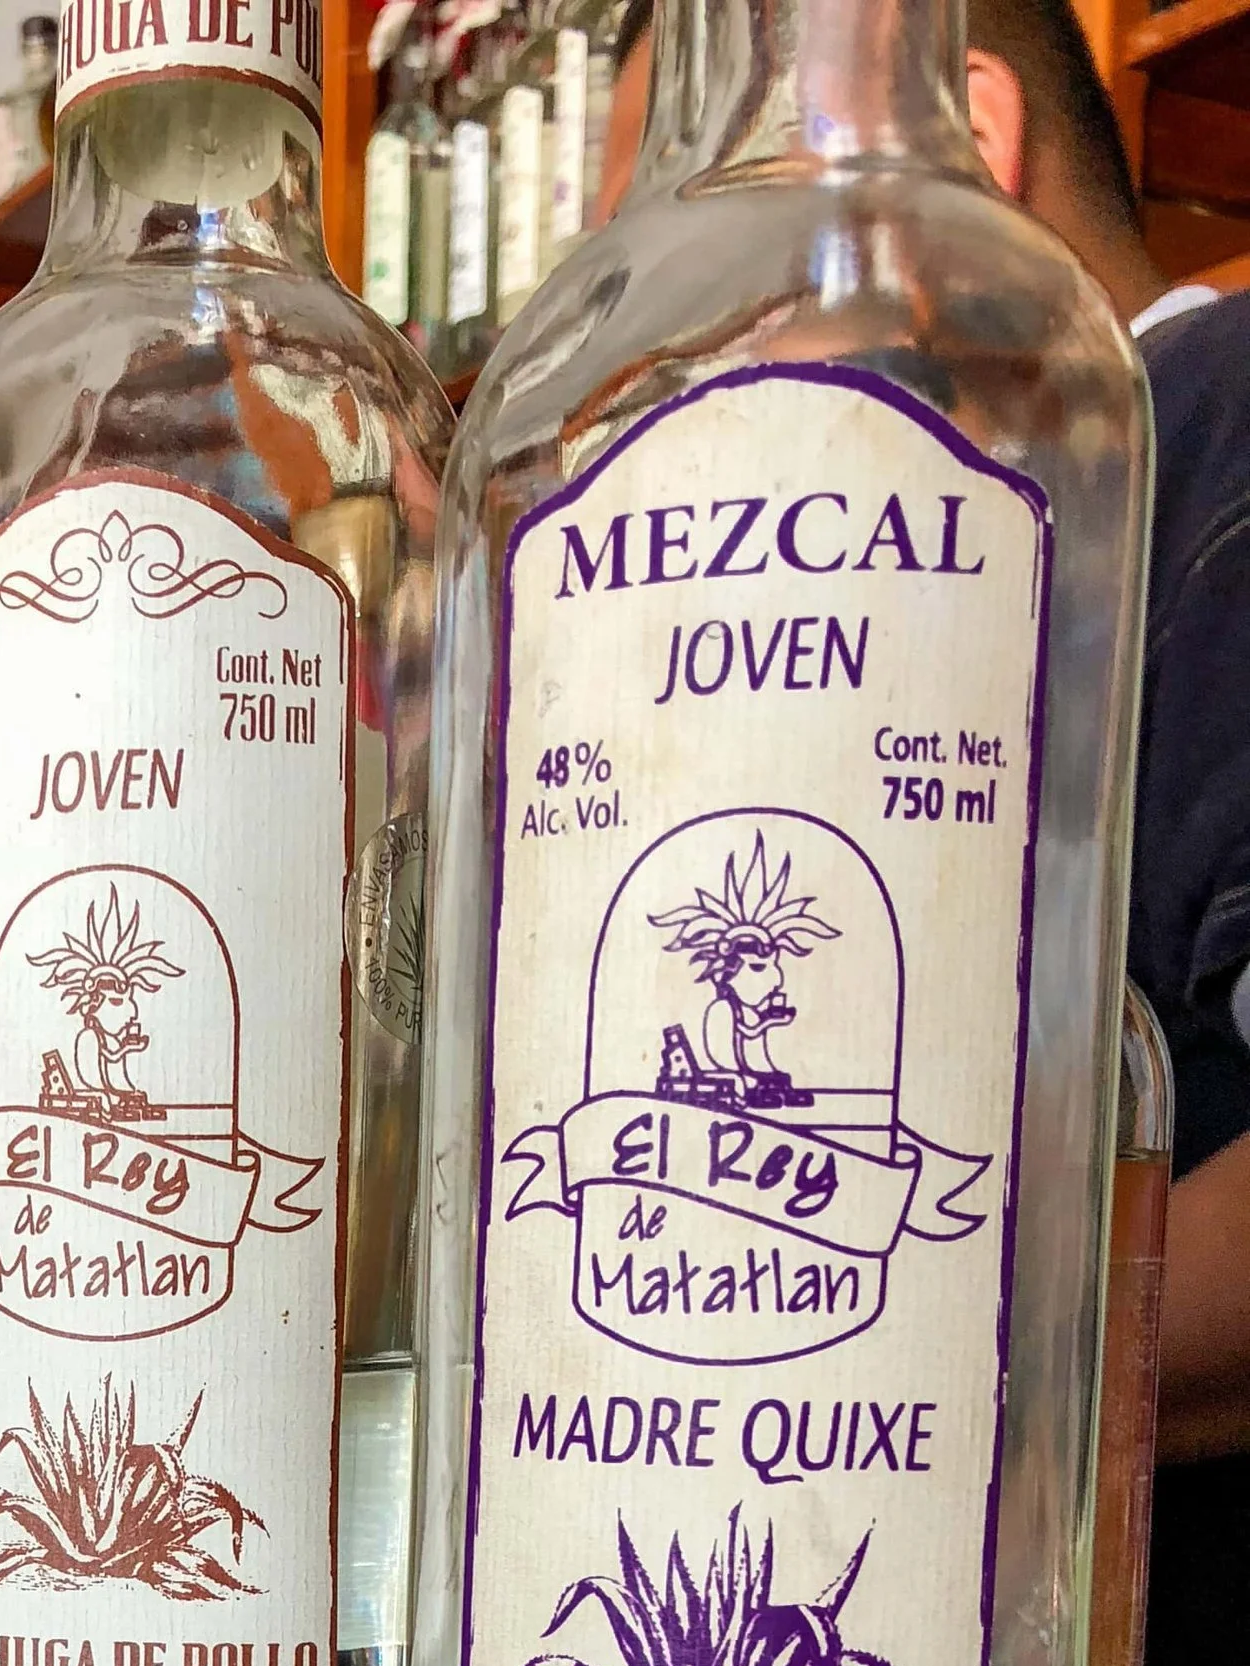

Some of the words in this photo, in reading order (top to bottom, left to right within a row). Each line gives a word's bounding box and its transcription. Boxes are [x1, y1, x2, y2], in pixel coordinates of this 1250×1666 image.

[187, 0, 253, 47] DE
[555, 493, 986, 600] MEZCAL
[216, 646, 275, 684] Cont.
[282, 647, 322, 688] Net
[655, 616, 869, 705] JOVEN
[219, 692, 276, 743] 750
[285, 697, 317, 745] ml
[875, 726, 947, 764] Cont.
[958, 730, 1008, 768] Net.
[30, 748, 185, 820] JOVEN
[882, 776, 944, 822] 750
[955, 779, 996, 824] ml
[521, 803, 566, 839] Alc.
[576, 791, 628, 829] Vol.
[6, 1124, 52, 1183] El
[83, 1131, 191, 1215] Rey
[613, 1112, 670, 1179] El
[707, 1121, 839, 1219] Rey
[14, 1194, 53, 1235] de
[618, 1194, 668, 1241] de
[591, 1248, 859, 1316] Matatlan
[512, 1393, 721, 1468] MADRE
[742, 1398, 937, 1484] QUIXE
